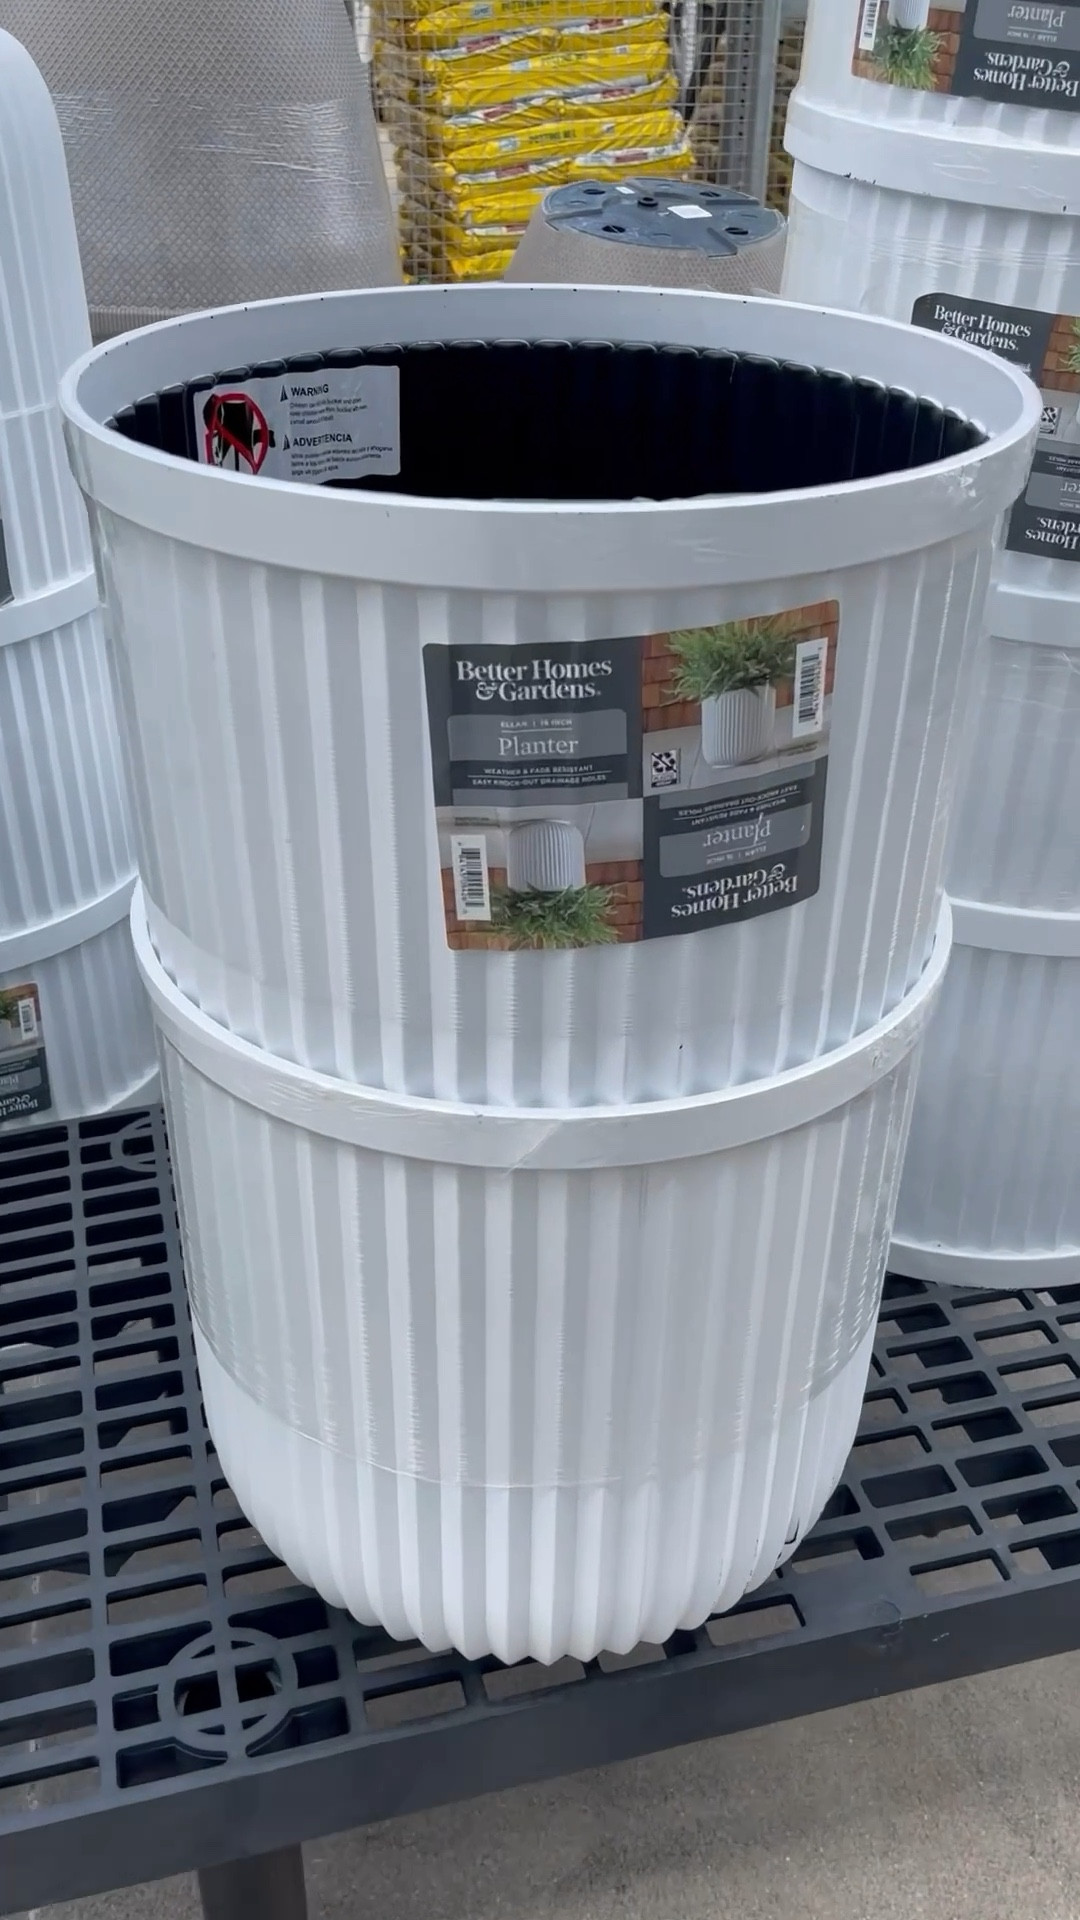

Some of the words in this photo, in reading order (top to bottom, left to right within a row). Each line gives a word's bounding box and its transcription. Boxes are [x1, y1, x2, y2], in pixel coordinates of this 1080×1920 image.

[1007, 5, 1066, 28] Planter
[973, 67, 1027, 91] Homes
[1028, 75, 1079, 97] Better
[934, 304, 978, 327] Better
[978, 313, 1032, 338] Homes
[1025, 528, 1080, 550] Homes
[456, 660, 527, 682] Better
[532, 659, 612, 680] Homes
[498, 736, 579, 756] Planter
[472, 778, 492, 786] EASY
[493, 778, 538, 787] KNOCK-OUT
[540, 776, 580, 785] DRAINAGE
[581, 774, 606, 783] HOLES
[530, 766, 550, 774] FADE
[552, 764, 593, 774] RESISTANT
[703, 817, 771, 848] Planter
[744, 875, 798, 904] Better
[671, 892, 739, 918] Homes
